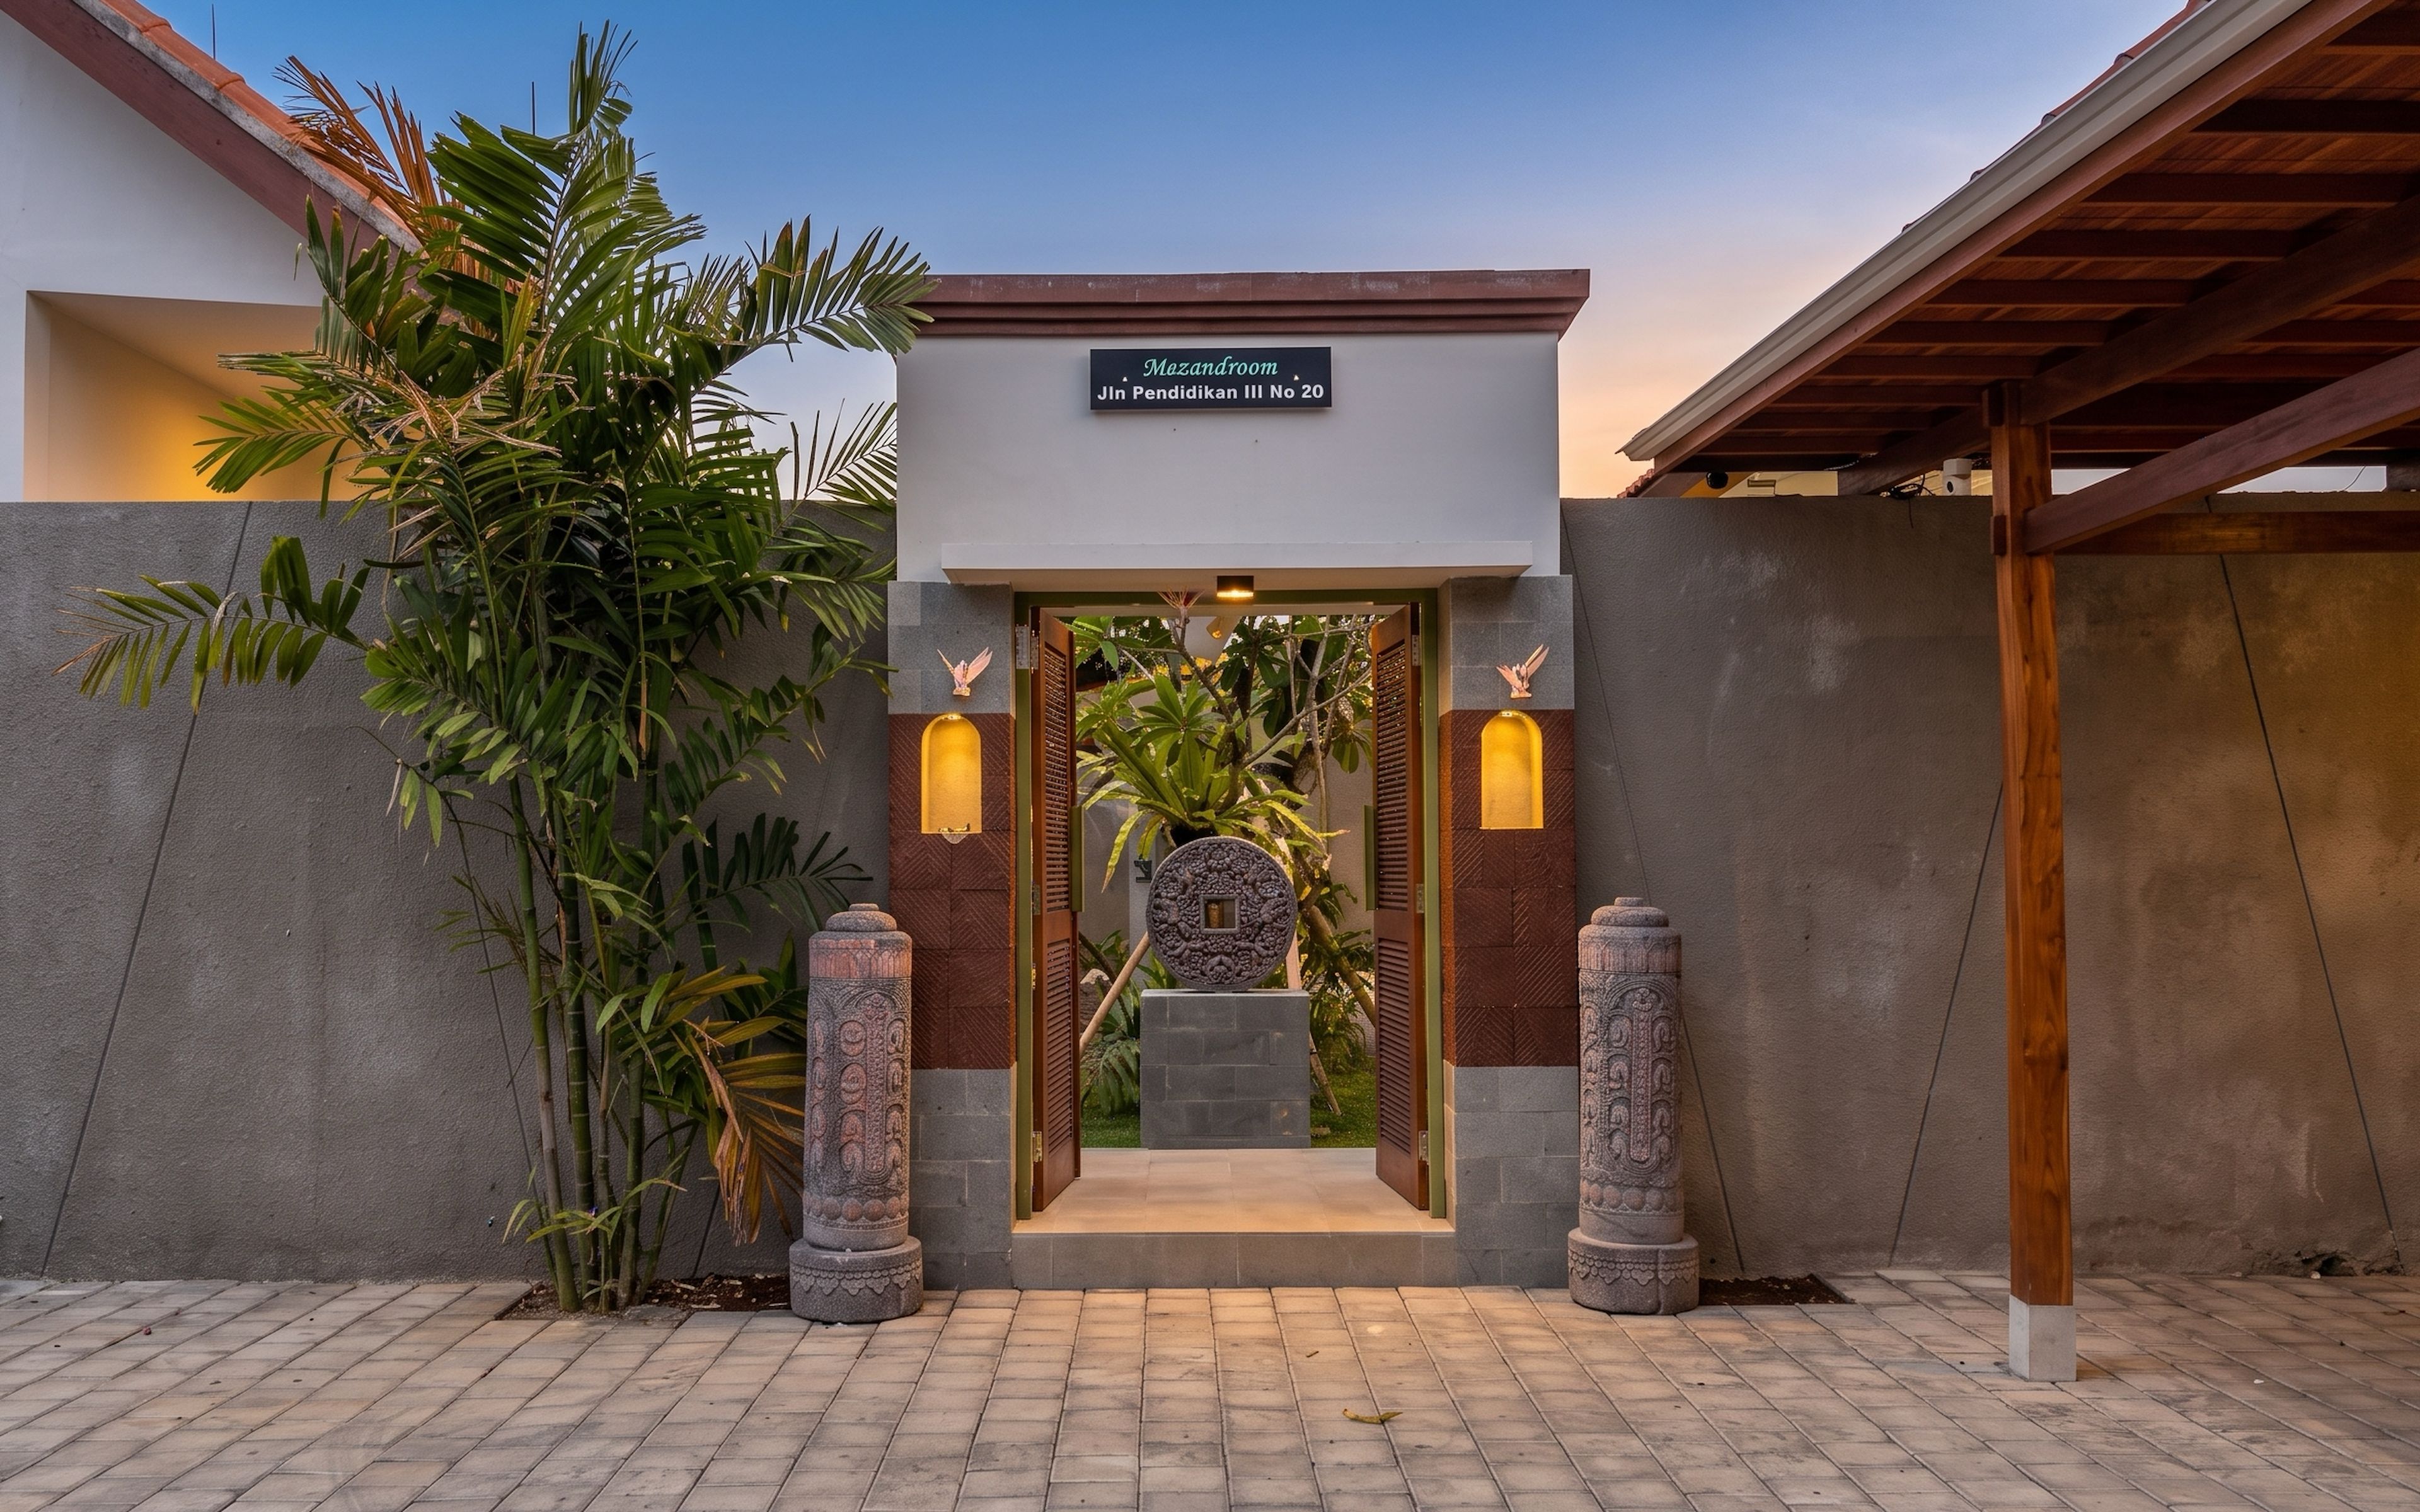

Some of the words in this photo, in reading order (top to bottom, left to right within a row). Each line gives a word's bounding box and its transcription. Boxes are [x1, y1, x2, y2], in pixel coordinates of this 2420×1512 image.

[1143, 356, 1277, 377] Mezandroom
[1098, 386, 1125, 400] Jln
[1133, 385, 1237, 399] Pendidikan
[1245, 385, 1262, 398] III
[1270, 385, 1294, 398] No
[1301, 384, 1323, 398] 20
